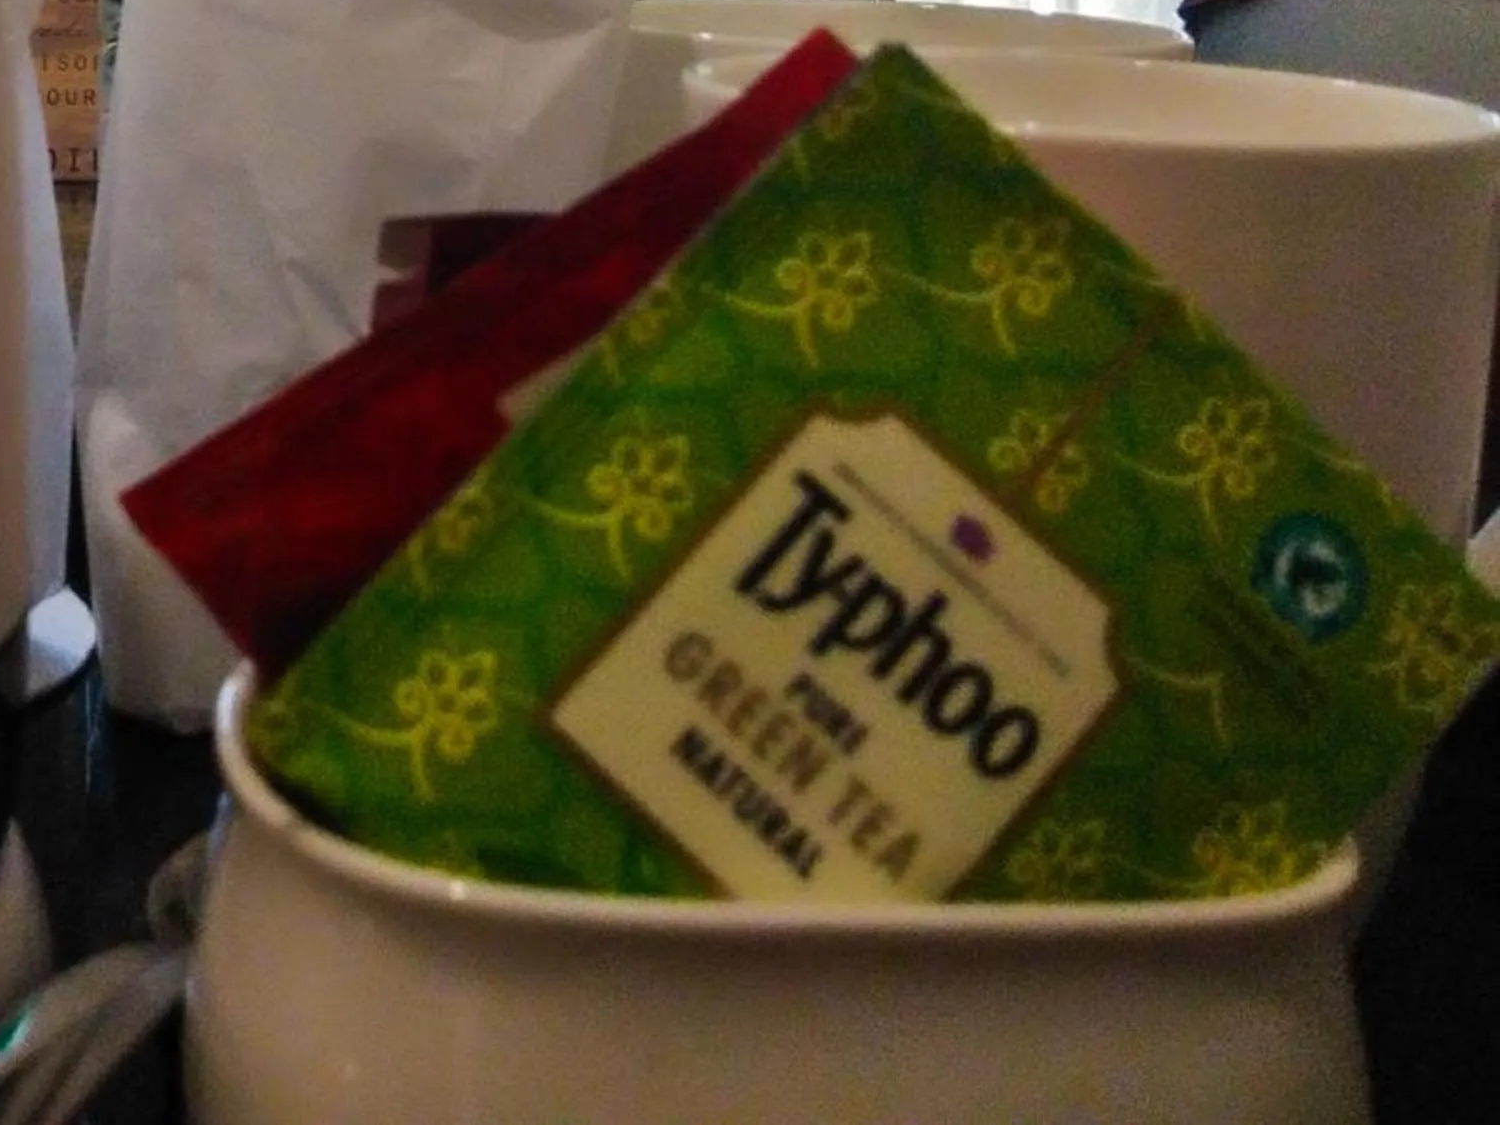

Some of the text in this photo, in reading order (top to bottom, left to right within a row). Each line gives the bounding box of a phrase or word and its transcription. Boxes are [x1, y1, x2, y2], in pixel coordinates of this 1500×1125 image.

[736, 470, 1041, 781] Typhoo
[664, 632, 922, 884] GREEN TEA
[670, 724, 823, 881] NATURAL
